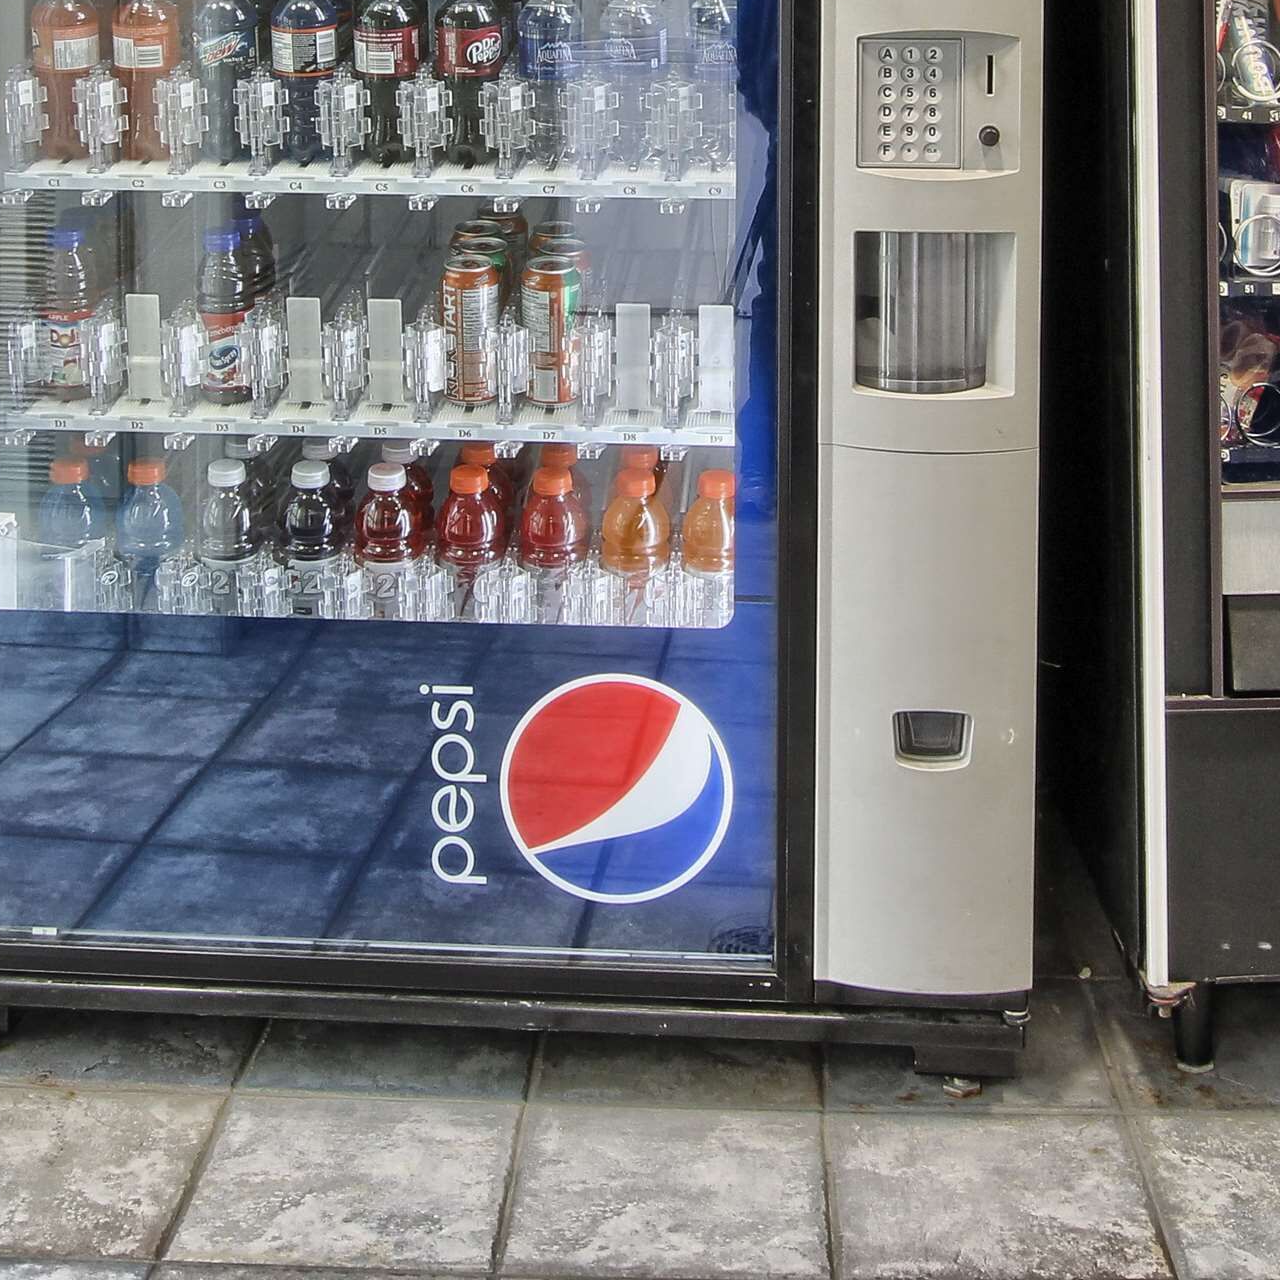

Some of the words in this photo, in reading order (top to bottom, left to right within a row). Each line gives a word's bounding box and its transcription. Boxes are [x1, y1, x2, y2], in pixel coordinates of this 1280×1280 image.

[466, 41, 502, 66] Pepper
[882, 48, 893, 59] A
[907, 49, 913, 59] 1
[929, 49, 937, 60] 2
[883, 68, 892, 78] B
[906, 68, 914, 78] 3
[929, 69, 937, 79] 4
[883, 87, 892, 97] C
[906, 87, 914, 97] 5
[929, 88, 937, 98] 6
[883, 106, 892, 117] D
[906, 107, 913, 117] 7
[929, 107, 937, 117] 8
[1242, 111, 1252, 120] 41
[883, 126, 891, 136] E
[906, 126, 913, 136] 9
[929, 126, 936, 136] 0
[883, 145, 891, 155] F
[48, 178, 60, 187] C1
[131, 179, 145, 188] C2
[213, 181, 226, 189] C3
[289, 182, 302, 190] C4
[375, 183, 388, 192] C5
[460, 184, 474, 193] C6
[542, 185, 556, 194] C7
[623, 186, 637, 195] C8
[708, 187, 722, 195] C9
[1244, 284, 1254, 294] 51
[54, 419, 66, 429] D1
[131, 421, 144, 430] D2
[216, 423, 229, 432] D3
[292, 425, 305, 433] D4
[374, 427, 387, 435] D5
[458, 429, 472, 438] D6
[543, 431, 555, 440] D7
[623, 432, 637, 441] D8
[418, 682, 488, 886] pepsi
